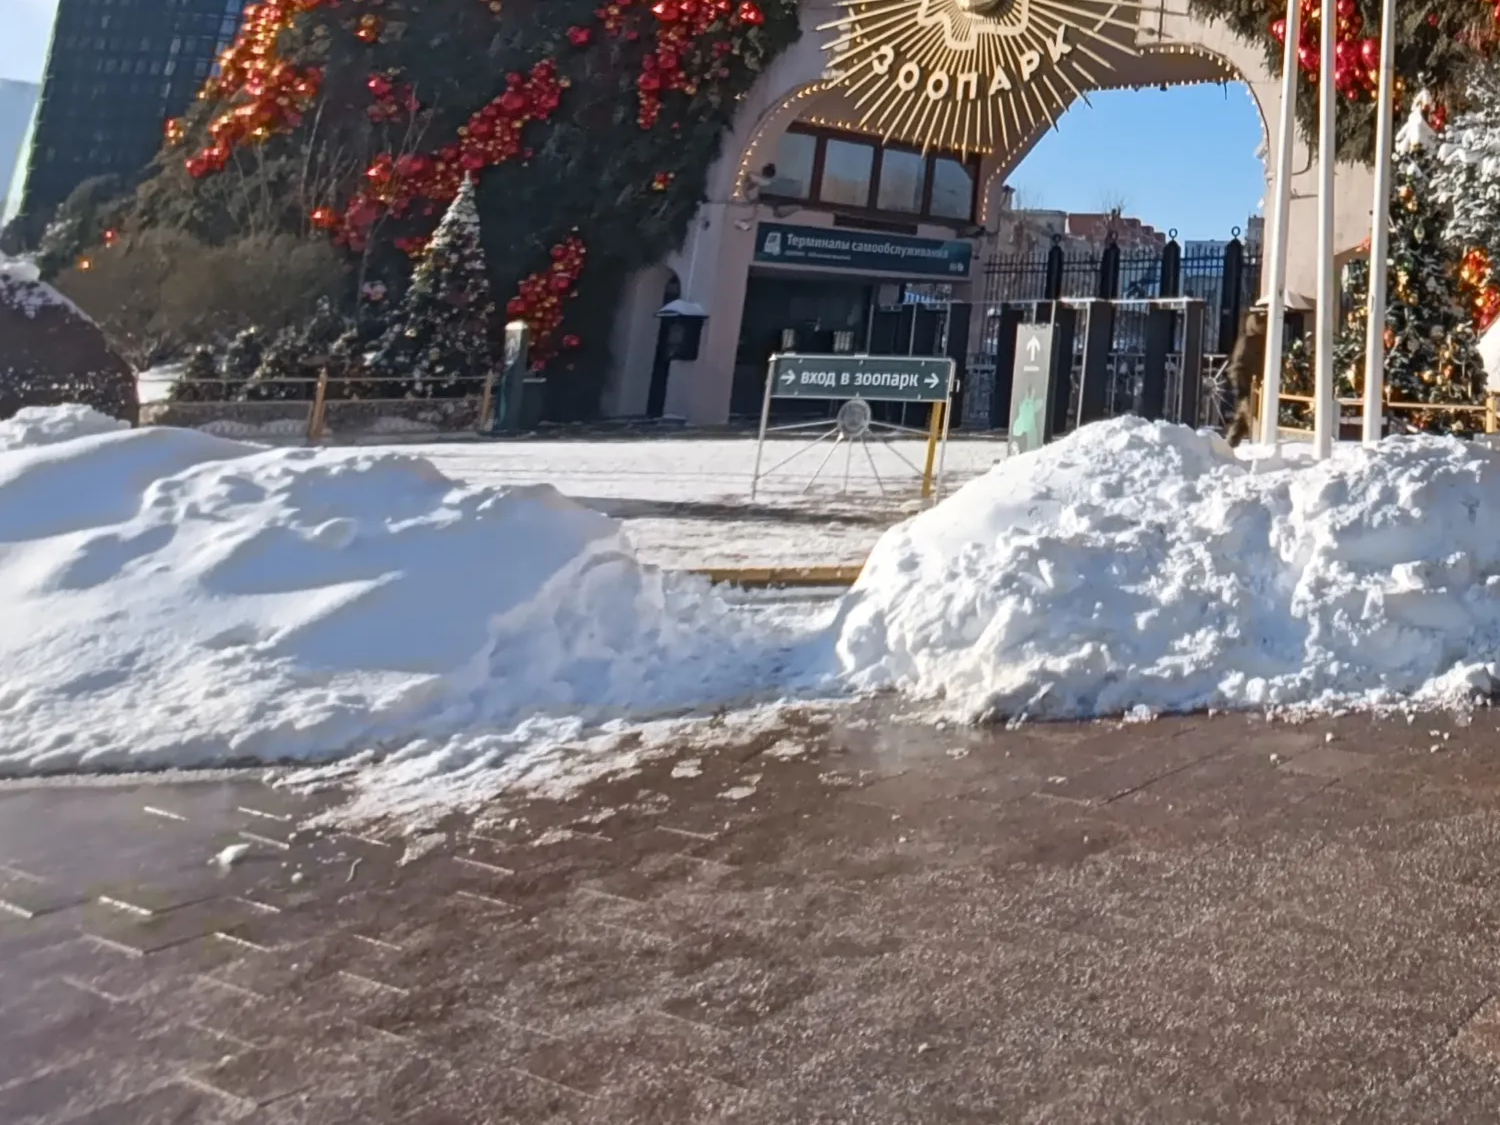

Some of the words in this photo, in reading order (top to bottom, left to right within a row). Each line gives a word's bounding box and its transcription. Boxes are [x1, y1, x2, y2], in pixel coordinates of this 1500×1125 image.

[873, 24, 1072, 100] ЗООПАРК
[787, 233, 850, 251] Терминалы
[851, 241, 949, 260] самообслуживания
[800, 371, 836, 387] вход
[840, 372, 850, 385] в
[854, 373, 919, 390] зоопарк
